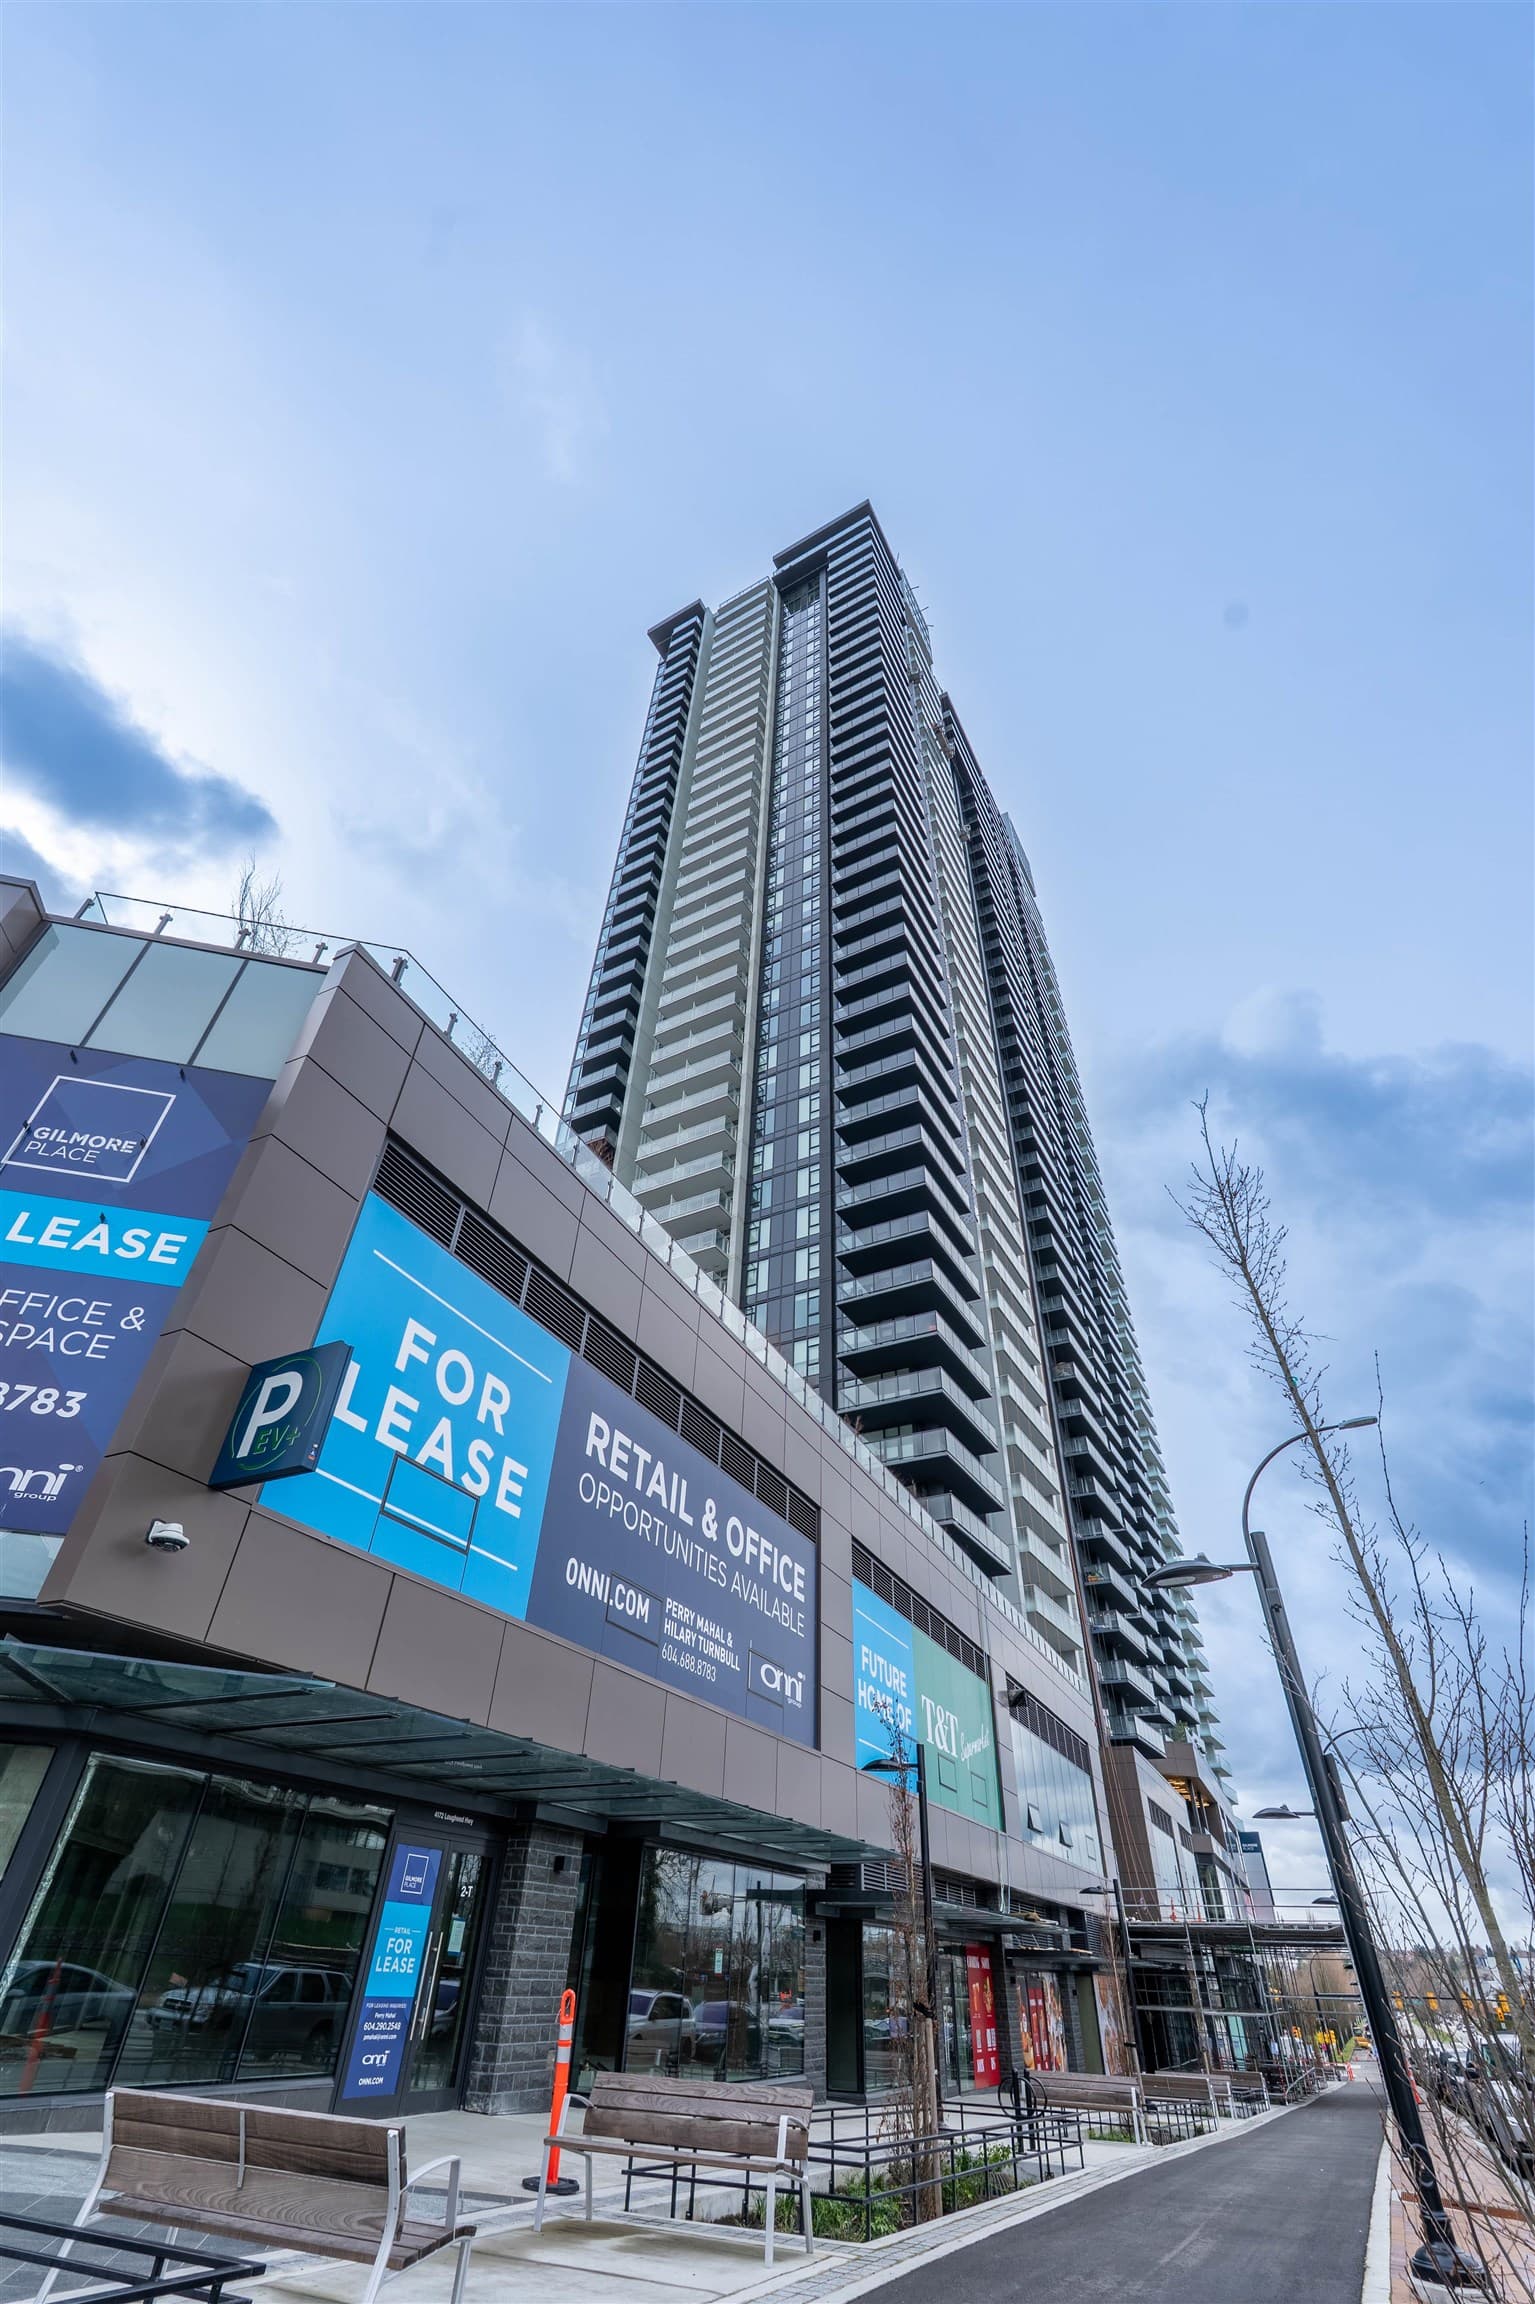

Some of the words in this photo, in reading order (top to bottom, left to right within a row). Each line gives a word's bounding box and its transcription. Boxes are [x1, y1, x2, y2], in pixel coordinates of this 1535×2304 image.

[24, 1140, 101, 1163] PLACE
[33, 1126, 137, 1154] GILMORE
[5, 1211, 188, 1265] LEASE
[120, 1306, 146, 1331] &
[394, 1317, 511, 1436] FOR
[236, 1370, 303, 1459] P
[333, 1360, 529, 1519] LEASE
[14, 1492, 57, 1502] group
[585, 1411, 694, 1527] RETAIL
[701, 1498, 718, 1542] &
[726, 1516, 806, 1603] OFFICE
[578, 1472, 728, 1588] OPPORTUNITIES
[731, 1570, 806, 1638] AVAILABLE
[565, 1557, 650, 1624] ONNI.COM
[663, 1617, 697, 1647] HILARY
[697, 1635, 741, 1672] TURNBULL
[665, 1597, 696, 1627] PERRY
[696, 1614, 726, 1644] MAHAL
[727, 1632, 734, 1648] &
[661, 1642, 717, 1683] 604.688.8783
[861, 1644, 908, 1698] FUTURE
[857, 1678, 894, 1725] HOME
[896, 1702, 912, 1735] OF
[921, 1694, 958, 1758] T&T
[403, 1881, 417, 1889] PLACE
[405, 1875, 422, 1883] GILMORE
[386, 1937, 413, 1954] FOR
[394, 1926, 411, 1935] RETAIL
[375, 1955, 416, 1974] LEASE
[358, 2077, 384, 2086] ONNI.COM
